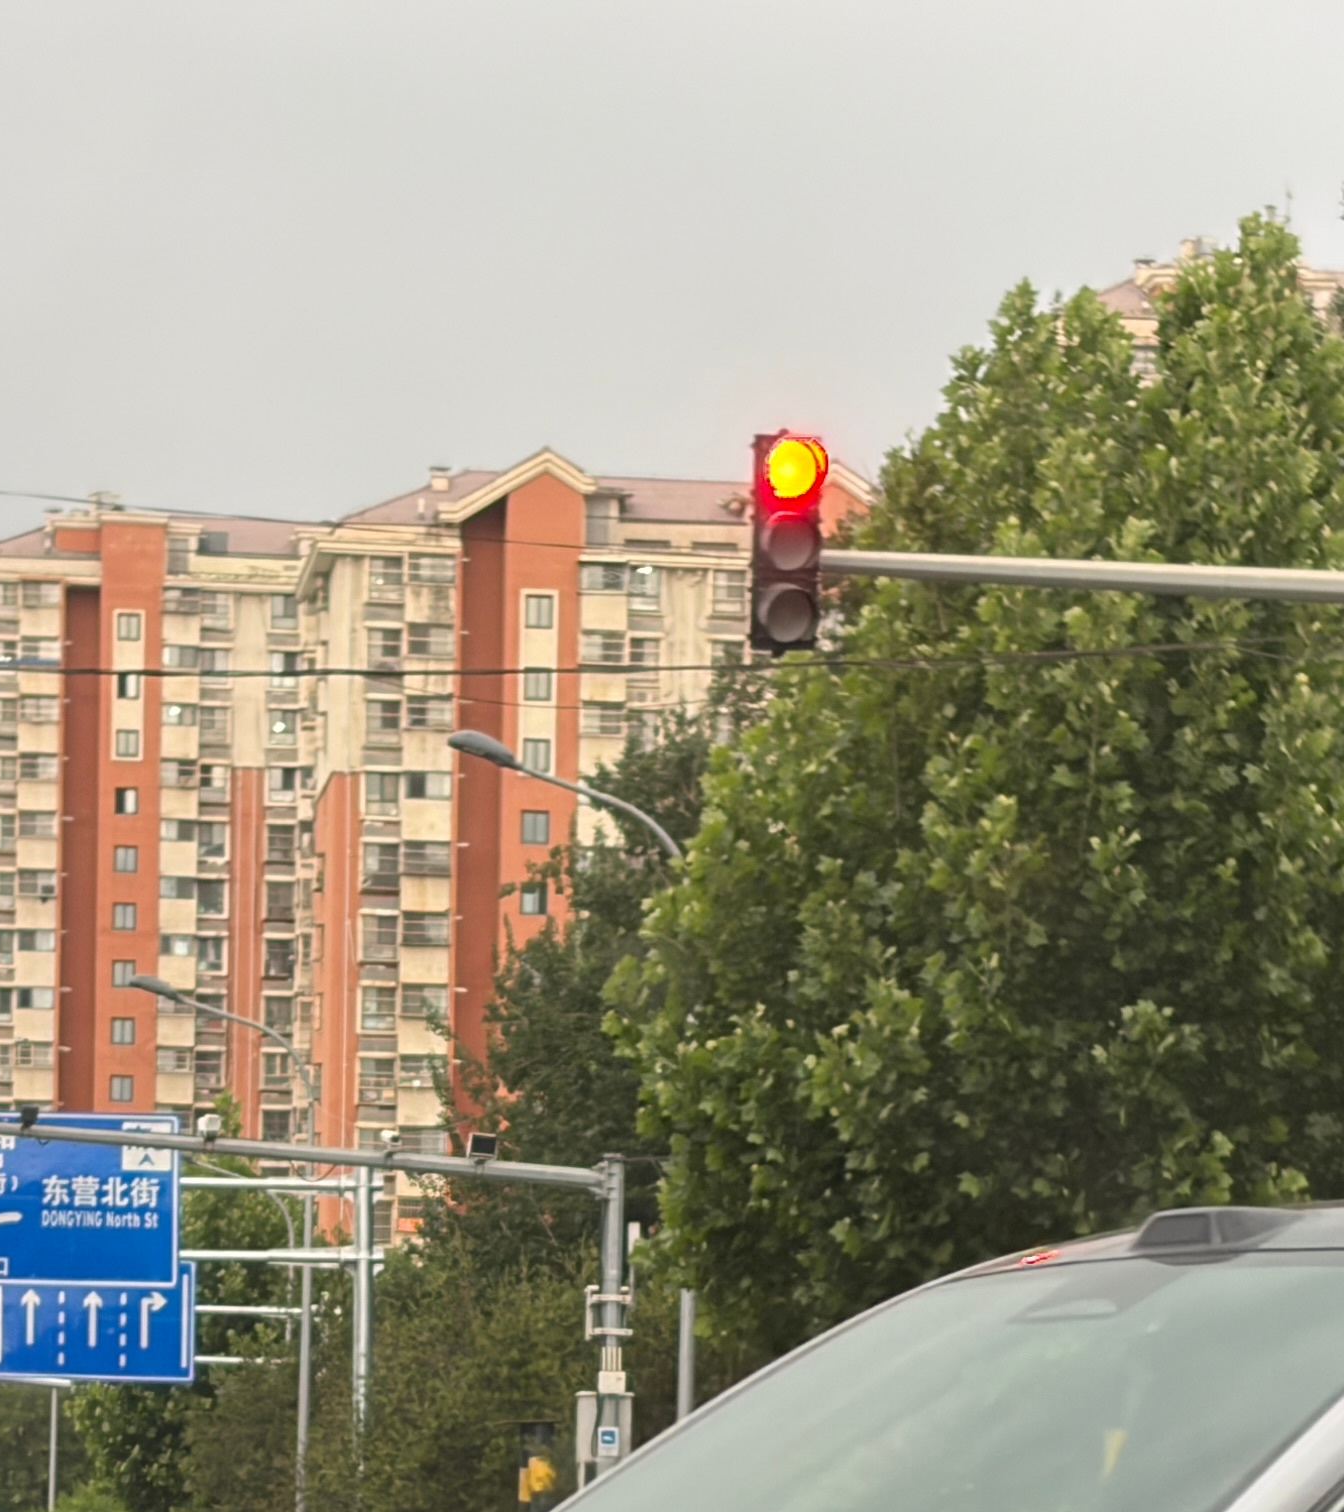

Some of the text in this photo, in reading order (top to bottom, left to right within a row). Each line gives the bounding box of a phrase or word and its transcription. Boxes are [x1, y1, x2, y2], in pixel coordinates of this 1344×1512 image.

[42, 1175, 160, 1208] 东营北街
[41, 1210, 159, 1229] DONGYING North St
